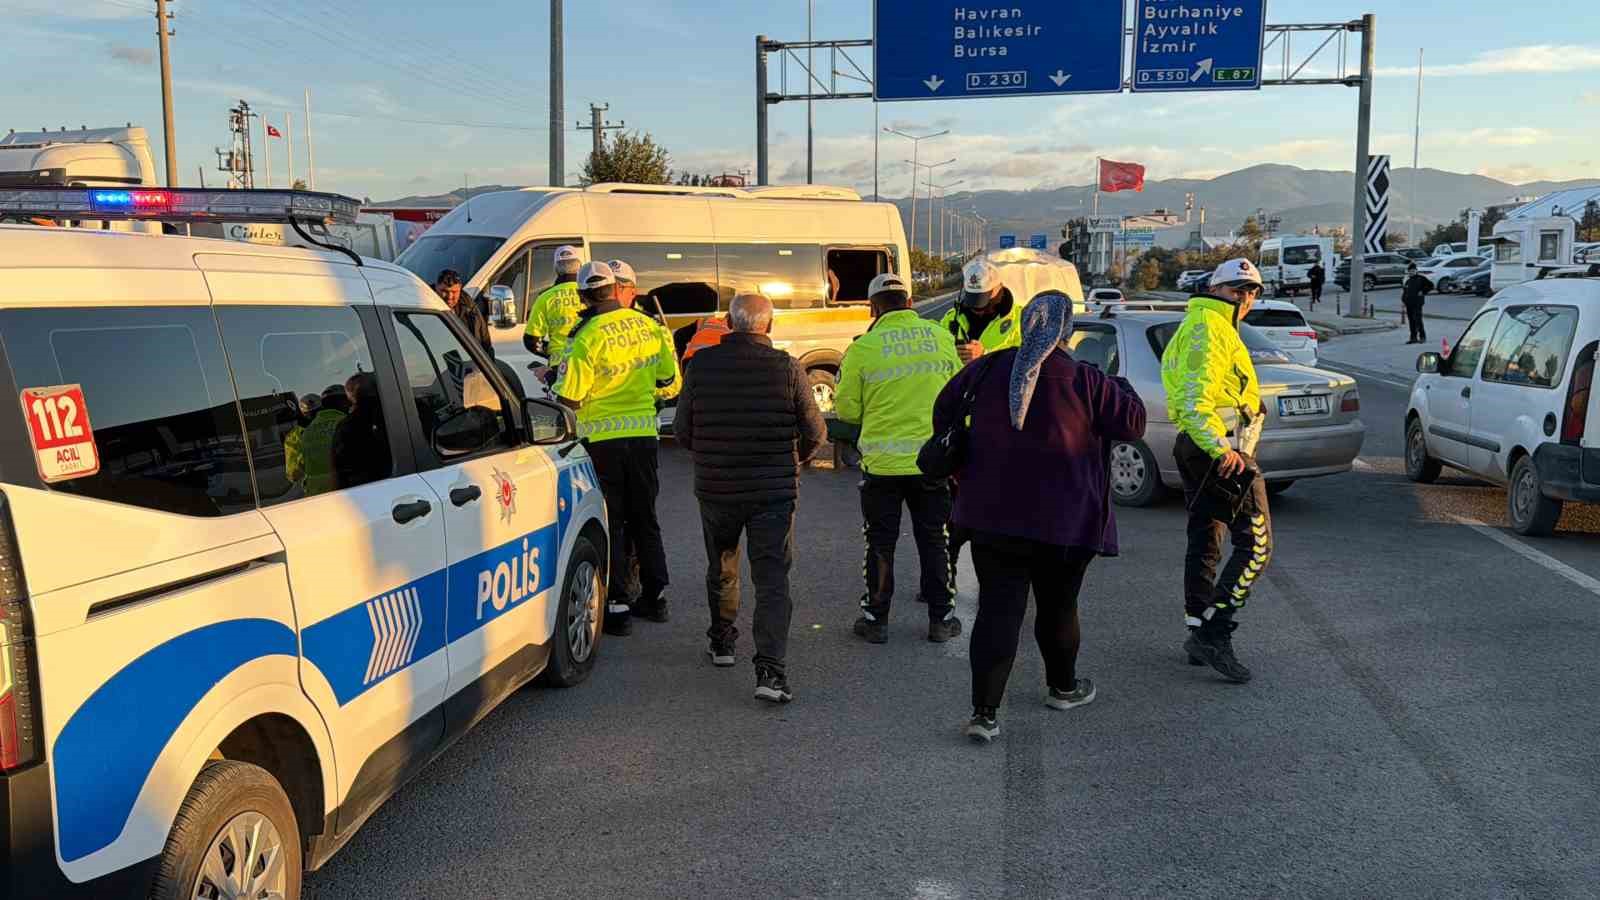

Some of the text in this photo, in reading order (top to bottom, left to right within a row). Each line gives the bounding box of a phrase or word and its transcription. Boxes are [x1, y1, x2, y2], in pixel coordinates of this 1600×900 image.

[954, 8, 1022, 20] Havran
[1144, 4, 1243, 20] Burhaniye
[954, 24, 1042, 39] Balıkesir
[1144, 22, 1218, 38] Ayvalık
[954, 44, 1008, 57] Bursa
[1143, 37, 1197, 53] İzmir
[32, 395, 84, 441] 112
[476, 538, 540, 620] POLİS
